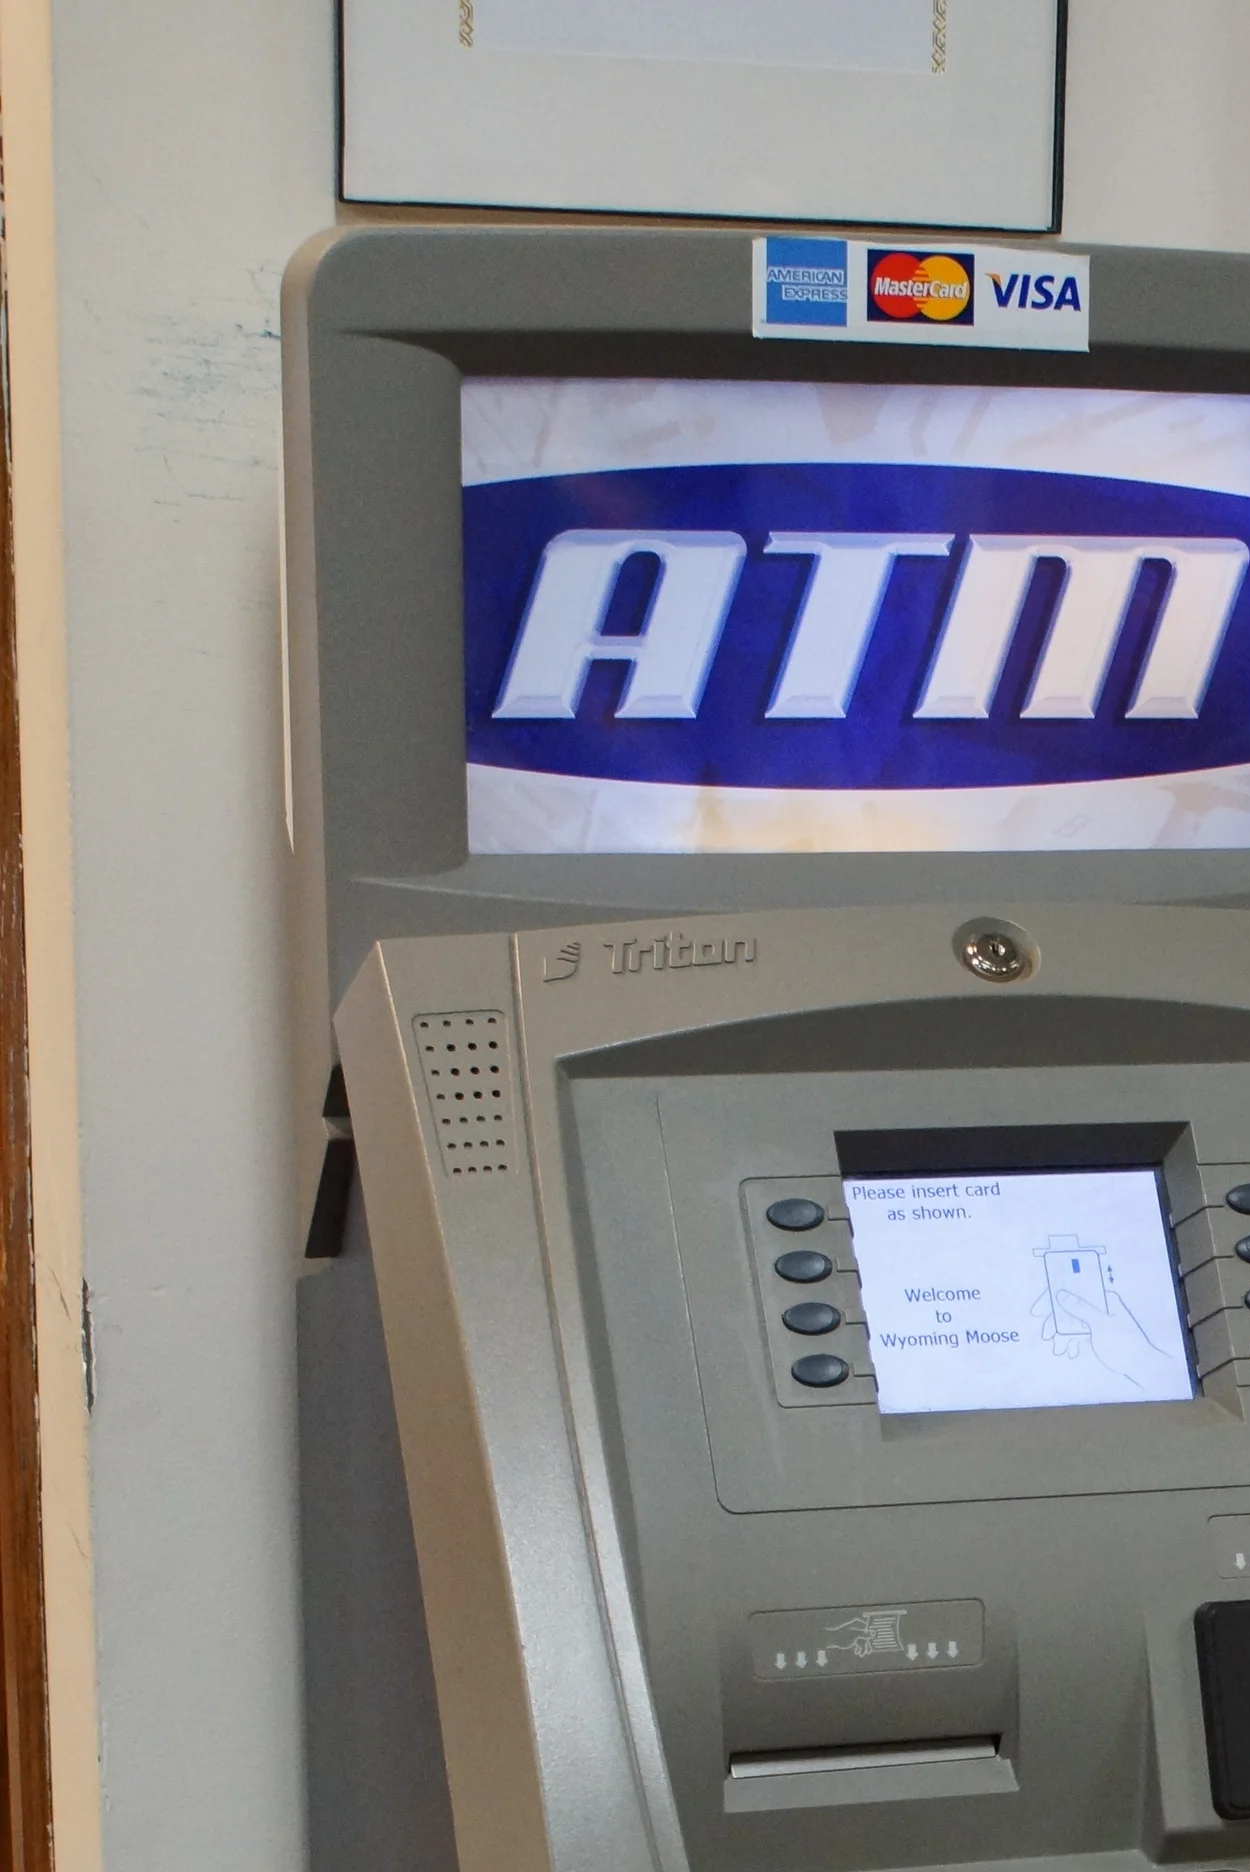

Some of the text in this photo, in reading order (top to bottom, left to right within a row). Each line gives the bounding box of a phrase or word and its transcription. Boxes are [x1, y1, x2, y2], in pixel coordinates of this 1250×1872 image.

[767, 268, 844, 286] AMERICAN
[783, 285, 848, 302] EXPRESS
[875, 275, 969, 300] MasterCard
[985, 272, 1082, 313] VISA
[491, 527, 1250, 721] ATM
[603, 932, 757, 975] Triton
[852, 1182, 1001, 1201] Please insert card
[887, 1205, 973, 1222] as shown.
[904, 1286, 982, 1303] Welcome
[935, 1310, 953, 1325] to
[880, 1329, 1021, 1349] Wyoming Moose
